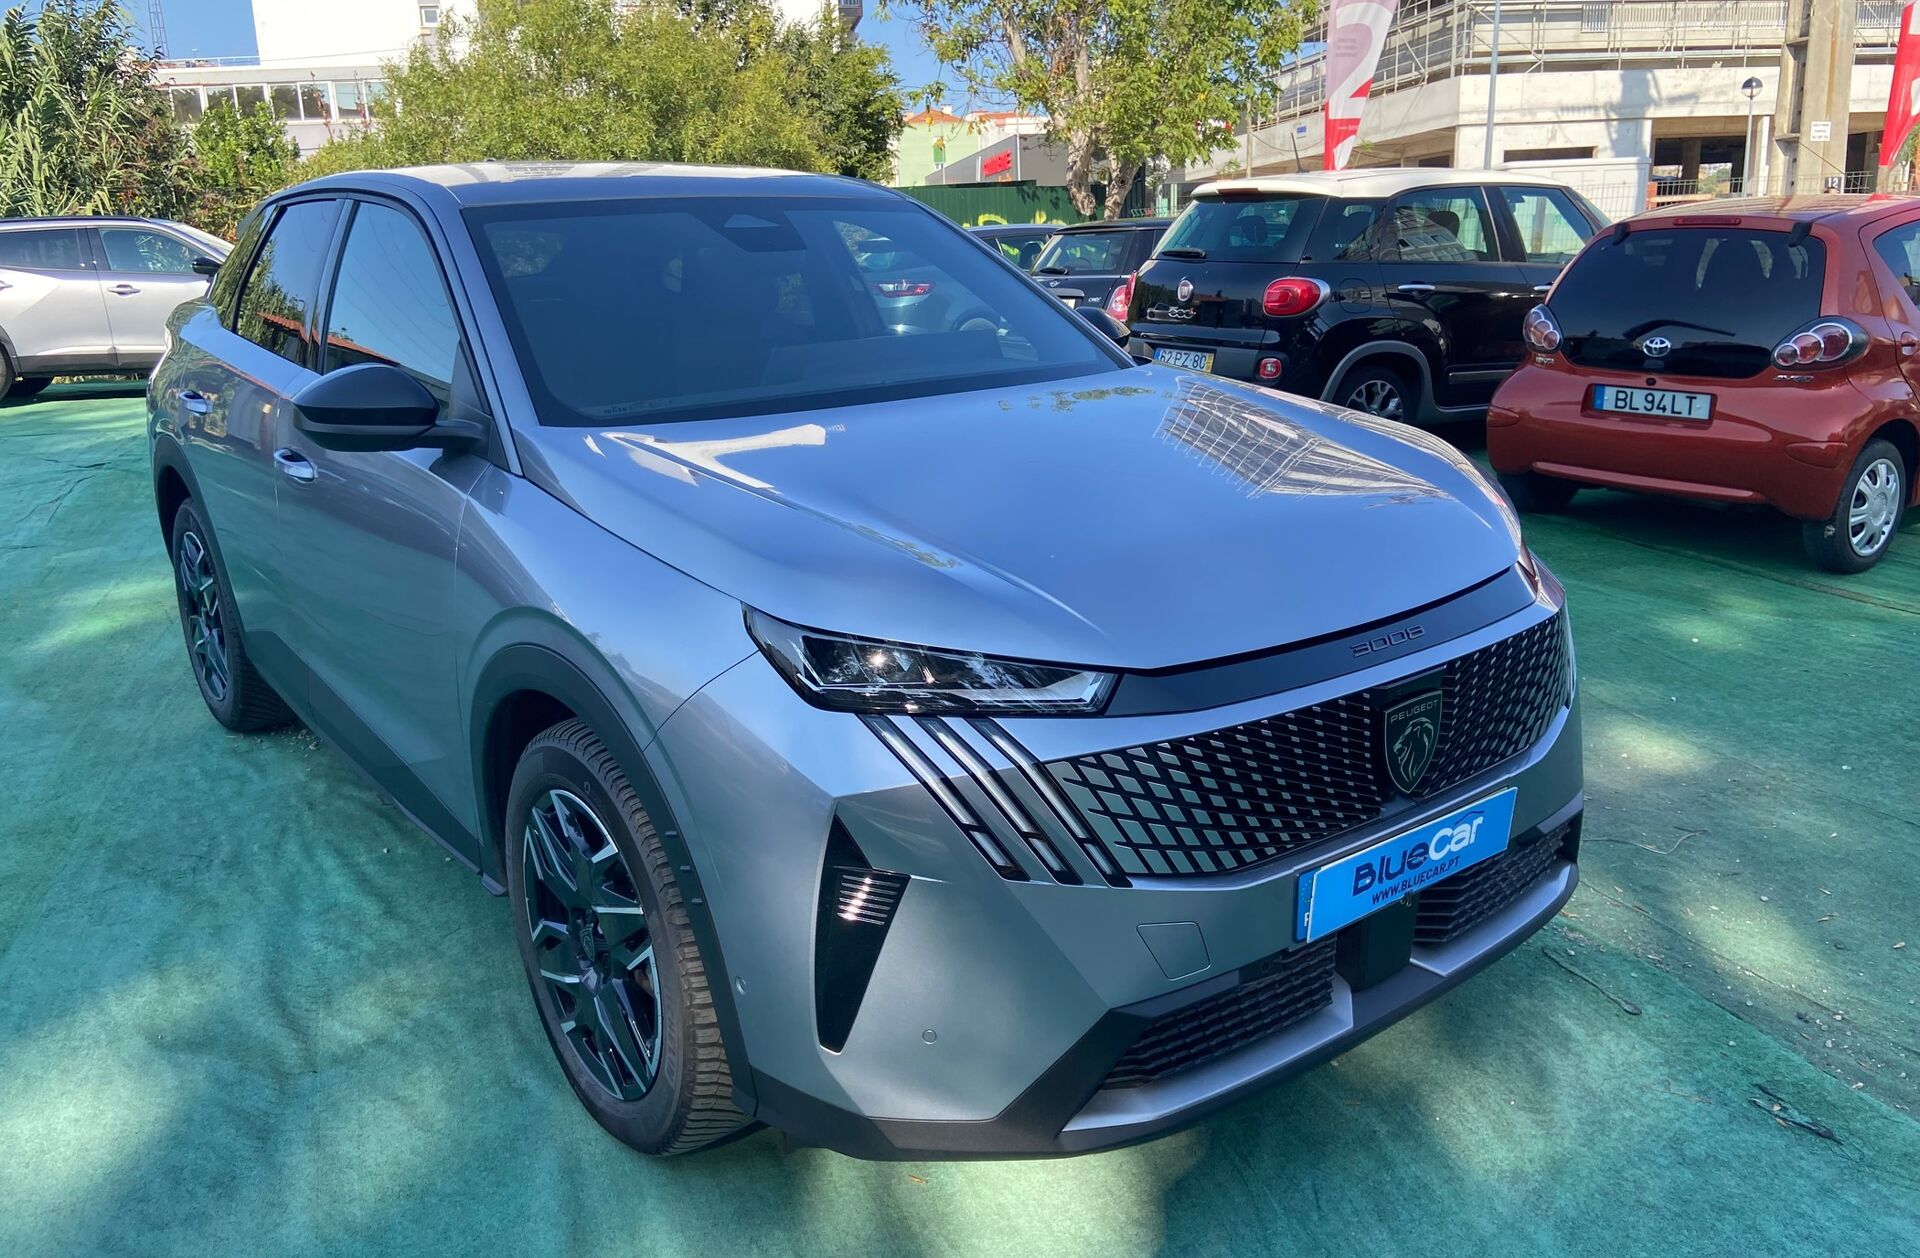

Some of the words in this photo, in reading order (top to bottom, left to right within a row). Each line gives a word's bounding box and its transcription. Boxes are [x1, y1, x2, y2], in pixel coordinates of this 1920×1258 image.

[1349, 624, 1425, 658] 3008
[1390, 700, 1439, 724] PEUGEOT
[1372, 856, 1461, 905] WWW.BLUECAR.PT
